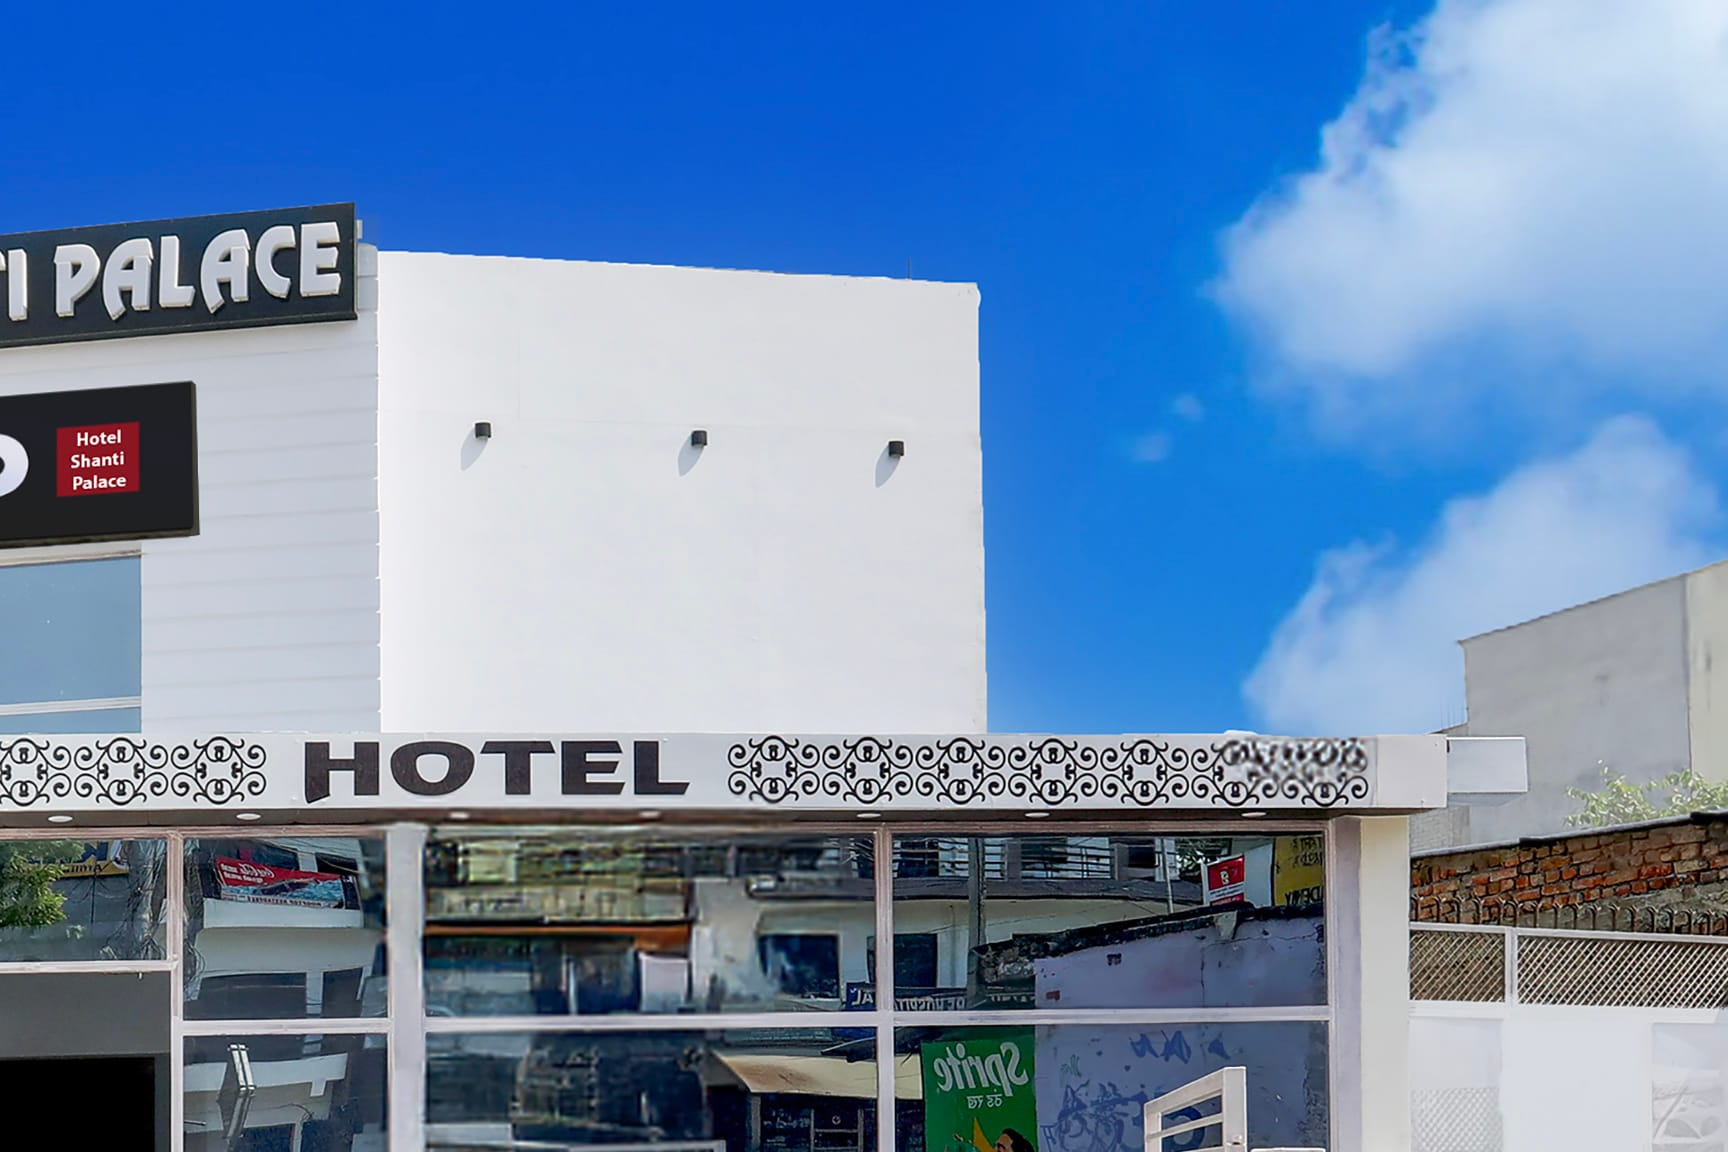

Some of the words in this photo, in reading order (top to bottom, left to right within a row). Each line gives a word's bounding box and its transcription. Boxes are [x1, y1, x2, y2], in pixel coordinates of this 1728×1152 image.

[53, 221, 342, 321] PALACE
[76, 428, 122, 447] Hotel
[70, 450, 125, 469] Shanti
[72, 474, 127, 491] Palace
[304, 740, 690, 803] HOTEL
